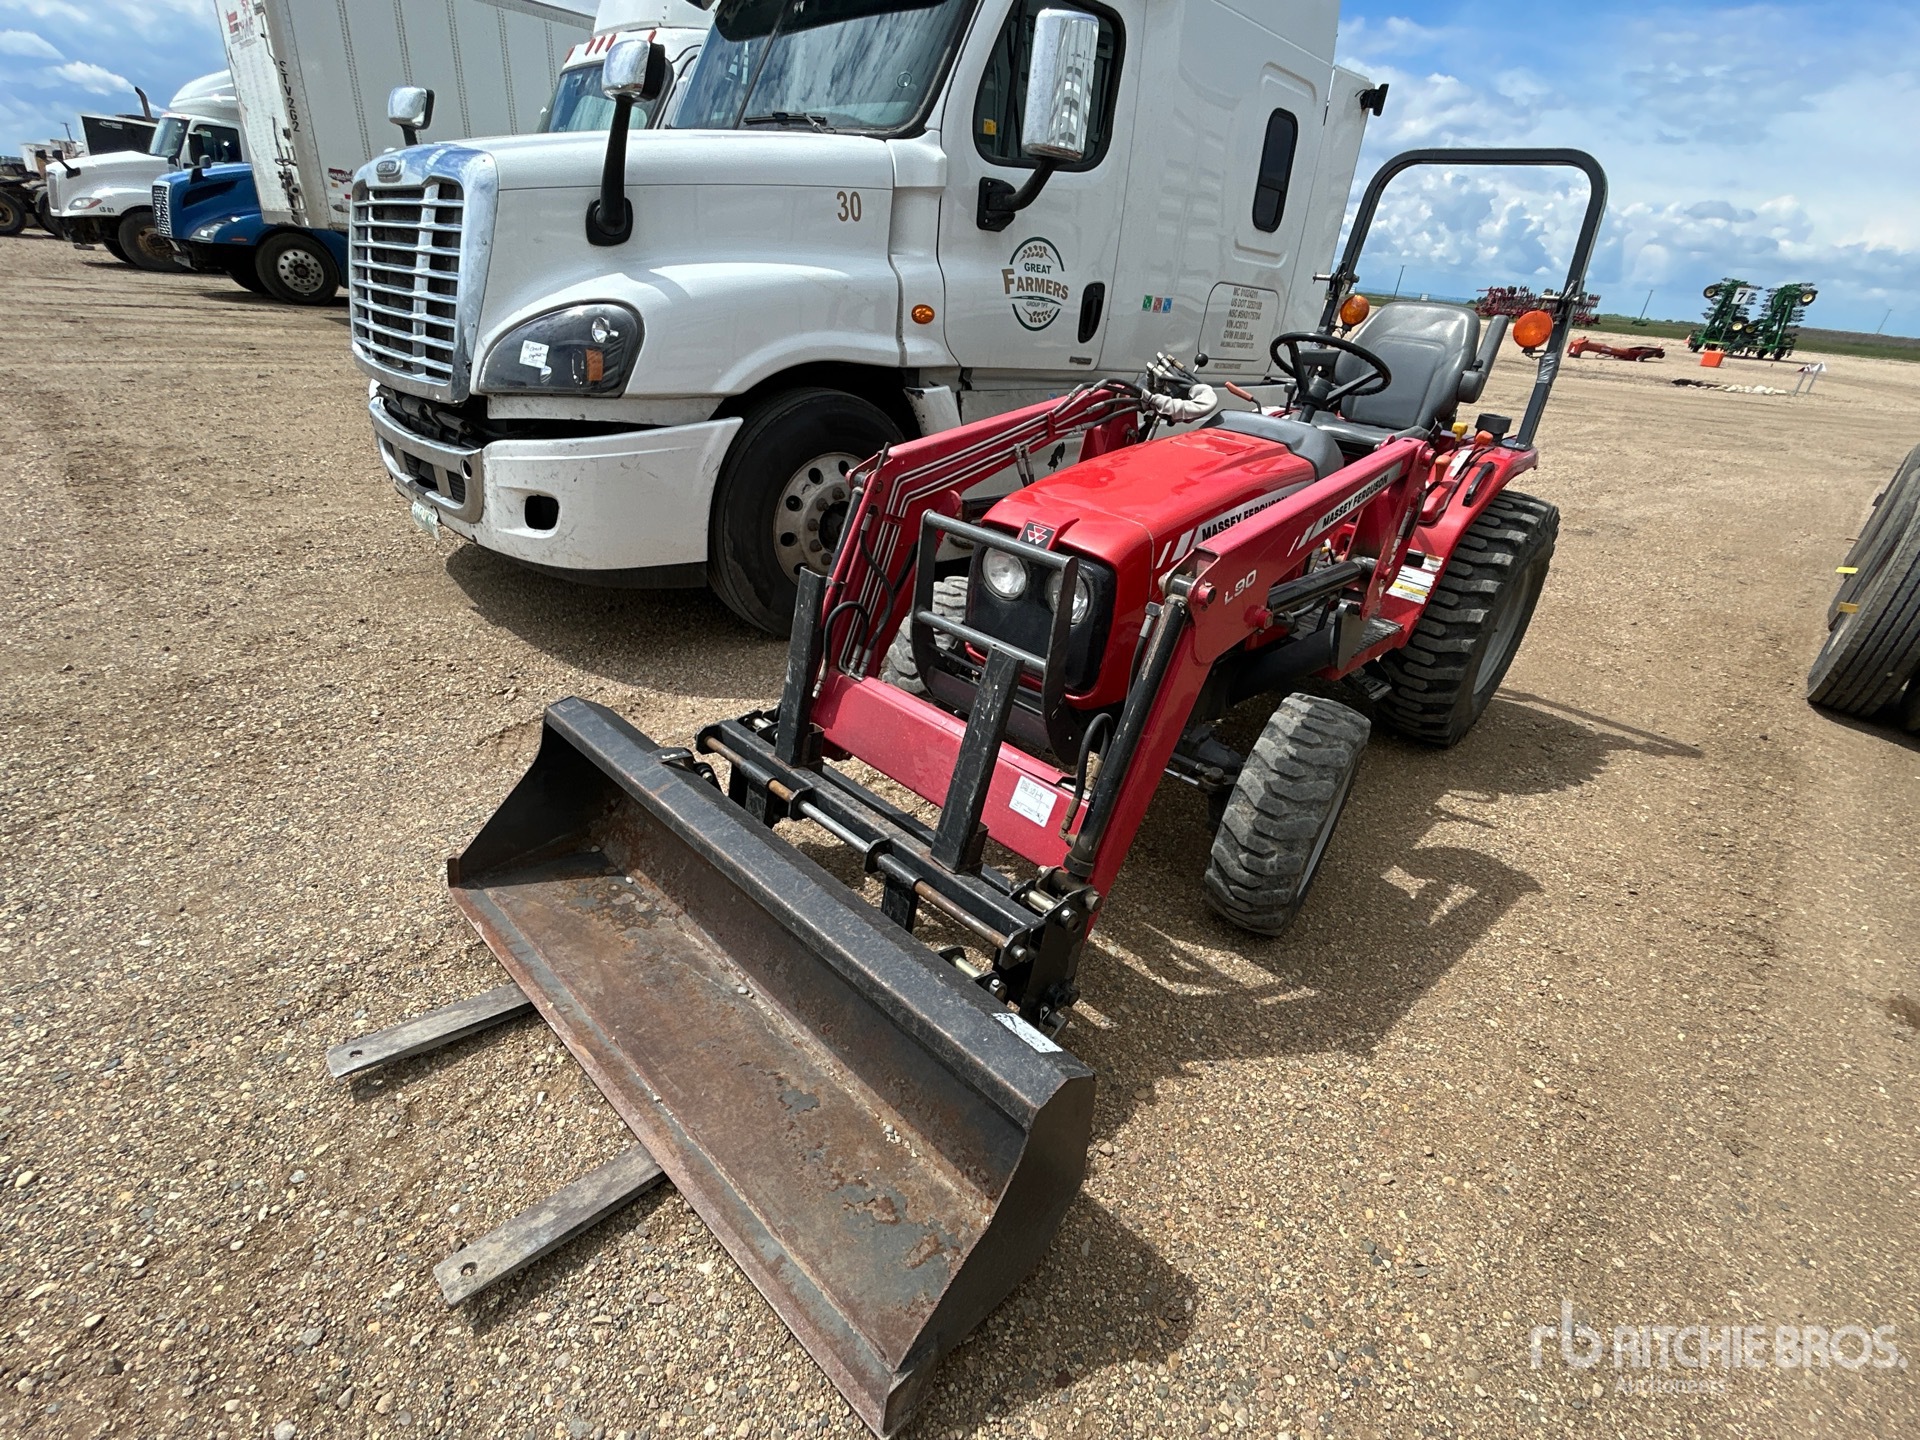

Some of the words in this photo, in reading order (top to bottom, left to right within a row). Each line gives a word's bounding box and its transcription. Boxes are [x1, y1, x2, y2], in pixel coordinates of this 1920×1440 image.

[836, 191, 862, 222] 30
[1024, 262, 1051, 274] GREAT
[1002, 268, 1069, 300] FARMERS
[1737, 292, 1747, 302] 7
[1231, 298, 1237, 307] US
[1237, 299, 1247, 309] DOT
[1322, 498, 1353, 529] MASSEY
[1353, 474, 1389, 507] FERGUSON
[1224, 569, 1257, 605] L90
